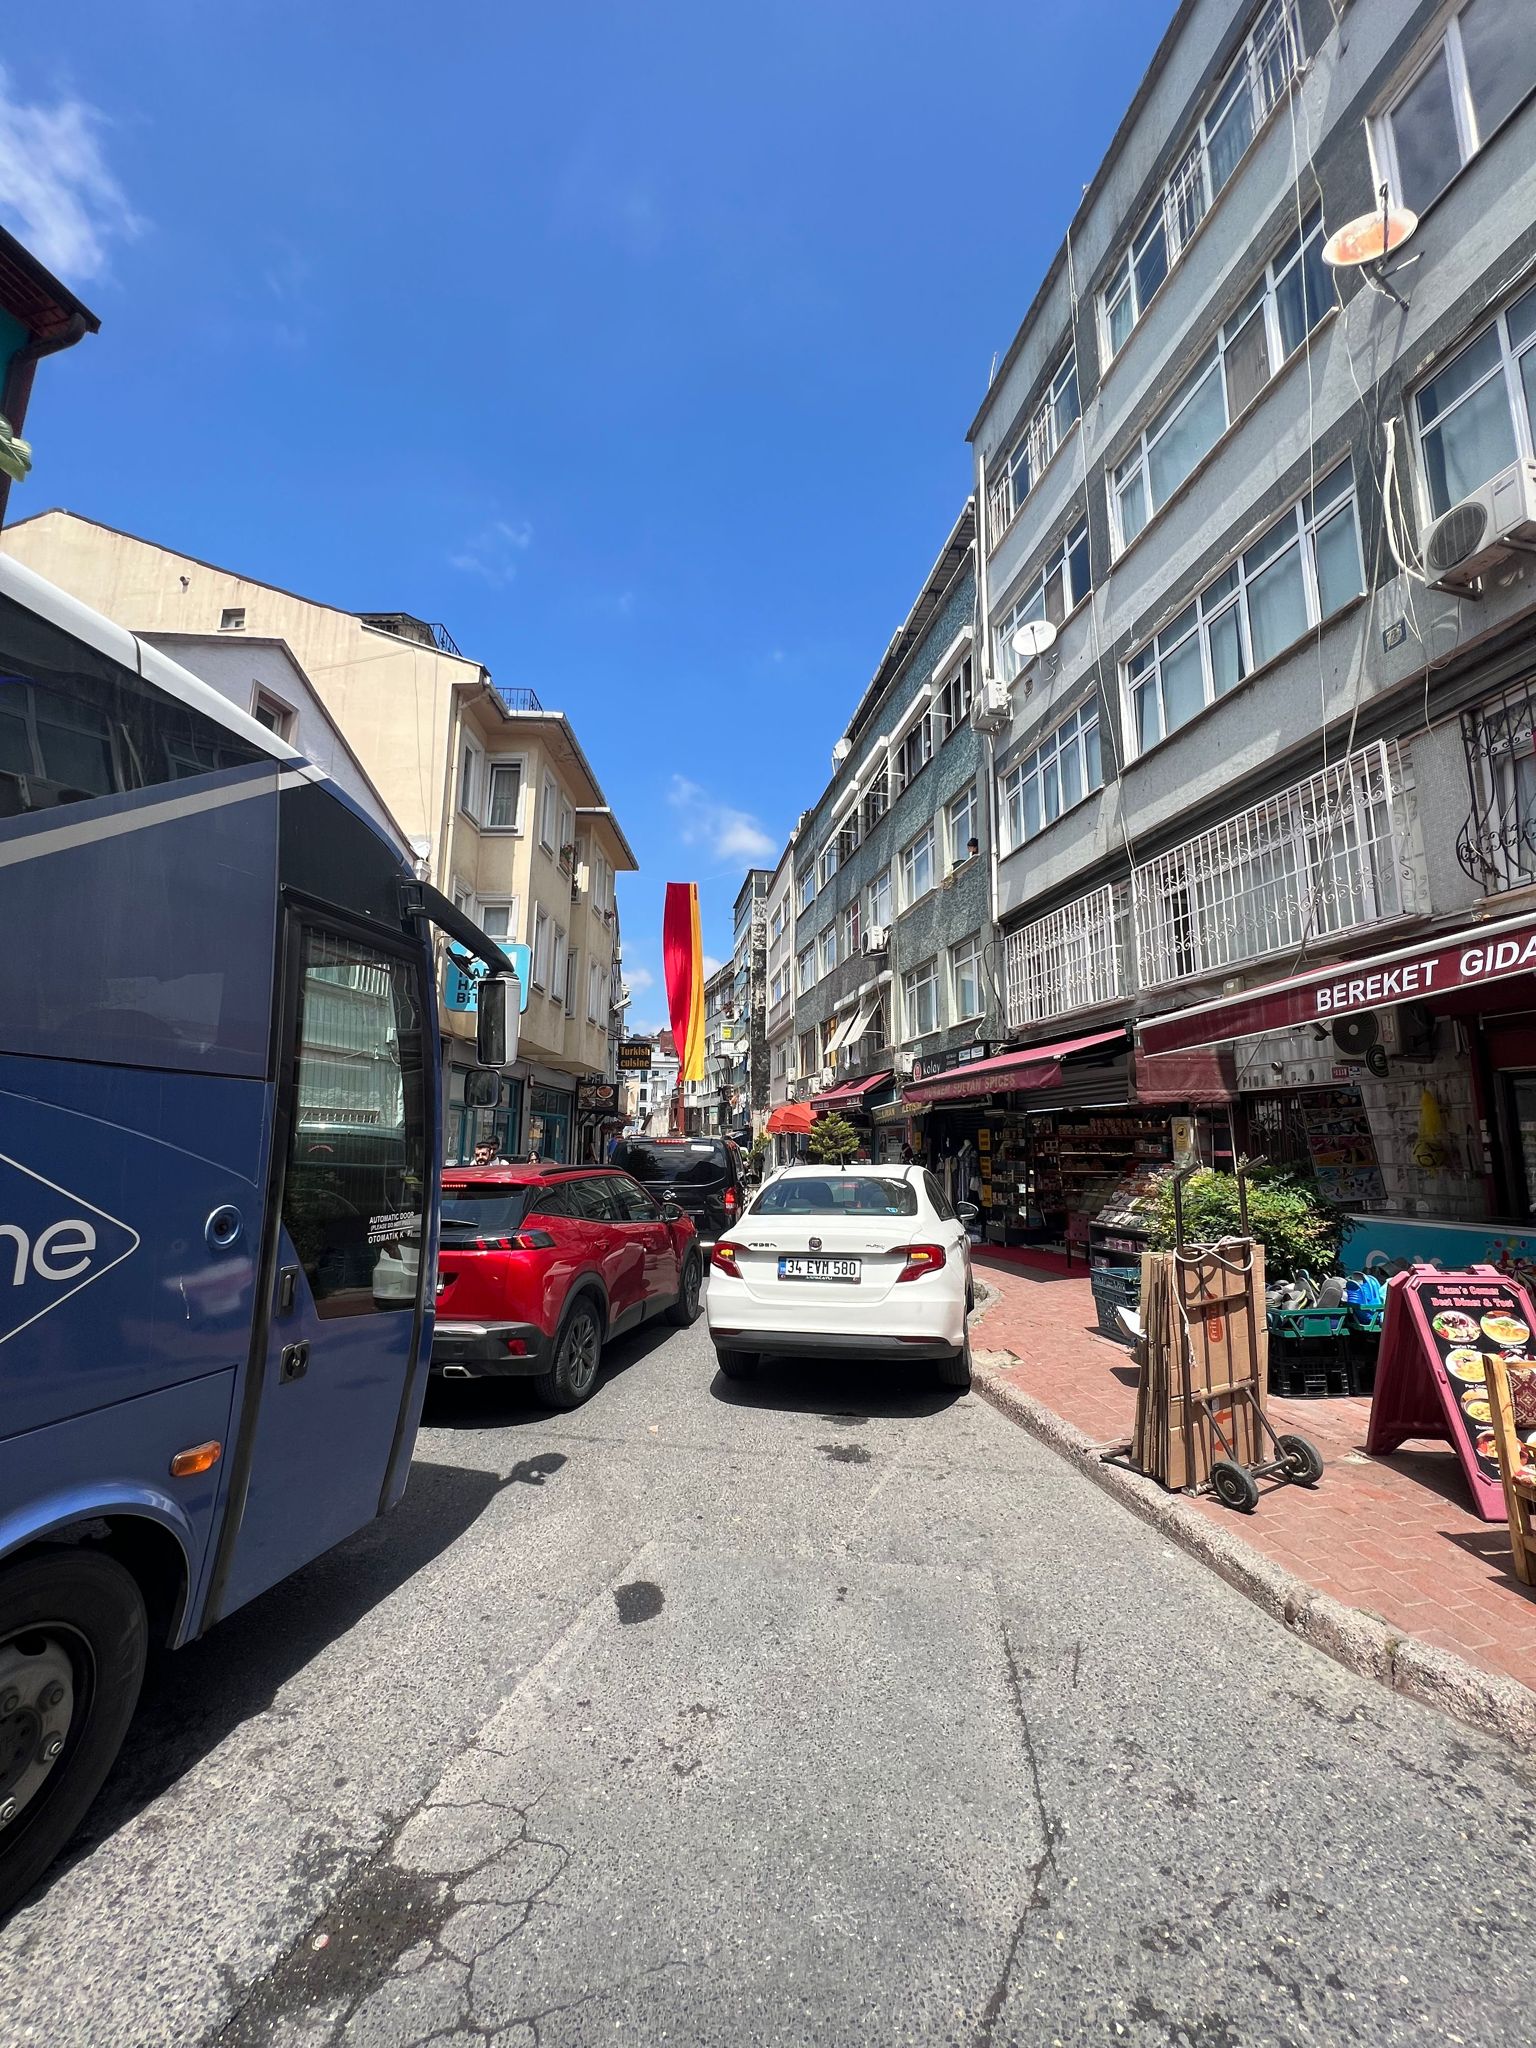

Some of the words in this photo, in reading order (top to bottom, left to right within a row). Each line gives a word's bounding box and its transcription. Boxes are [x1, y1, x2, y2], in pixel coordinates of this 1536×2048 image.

[1316, 960, 1439, 1012] BEREKET
[1459, 935, 1536, 977] GIDA
[620, 1046, 650, 1056] Turkish
[620, 1058, 650, 1067] cuisine
[984, 1073, 1017, 1090] SPICES
[369, 1213, 399, 1224] AUTOMATIC
[787, 1259, 802, 1275] 34
[806, 1260, 830, 1275] EVM
[833, 1261, 857, 1276] 580
[1482, 1298, 1493, 1307] &
